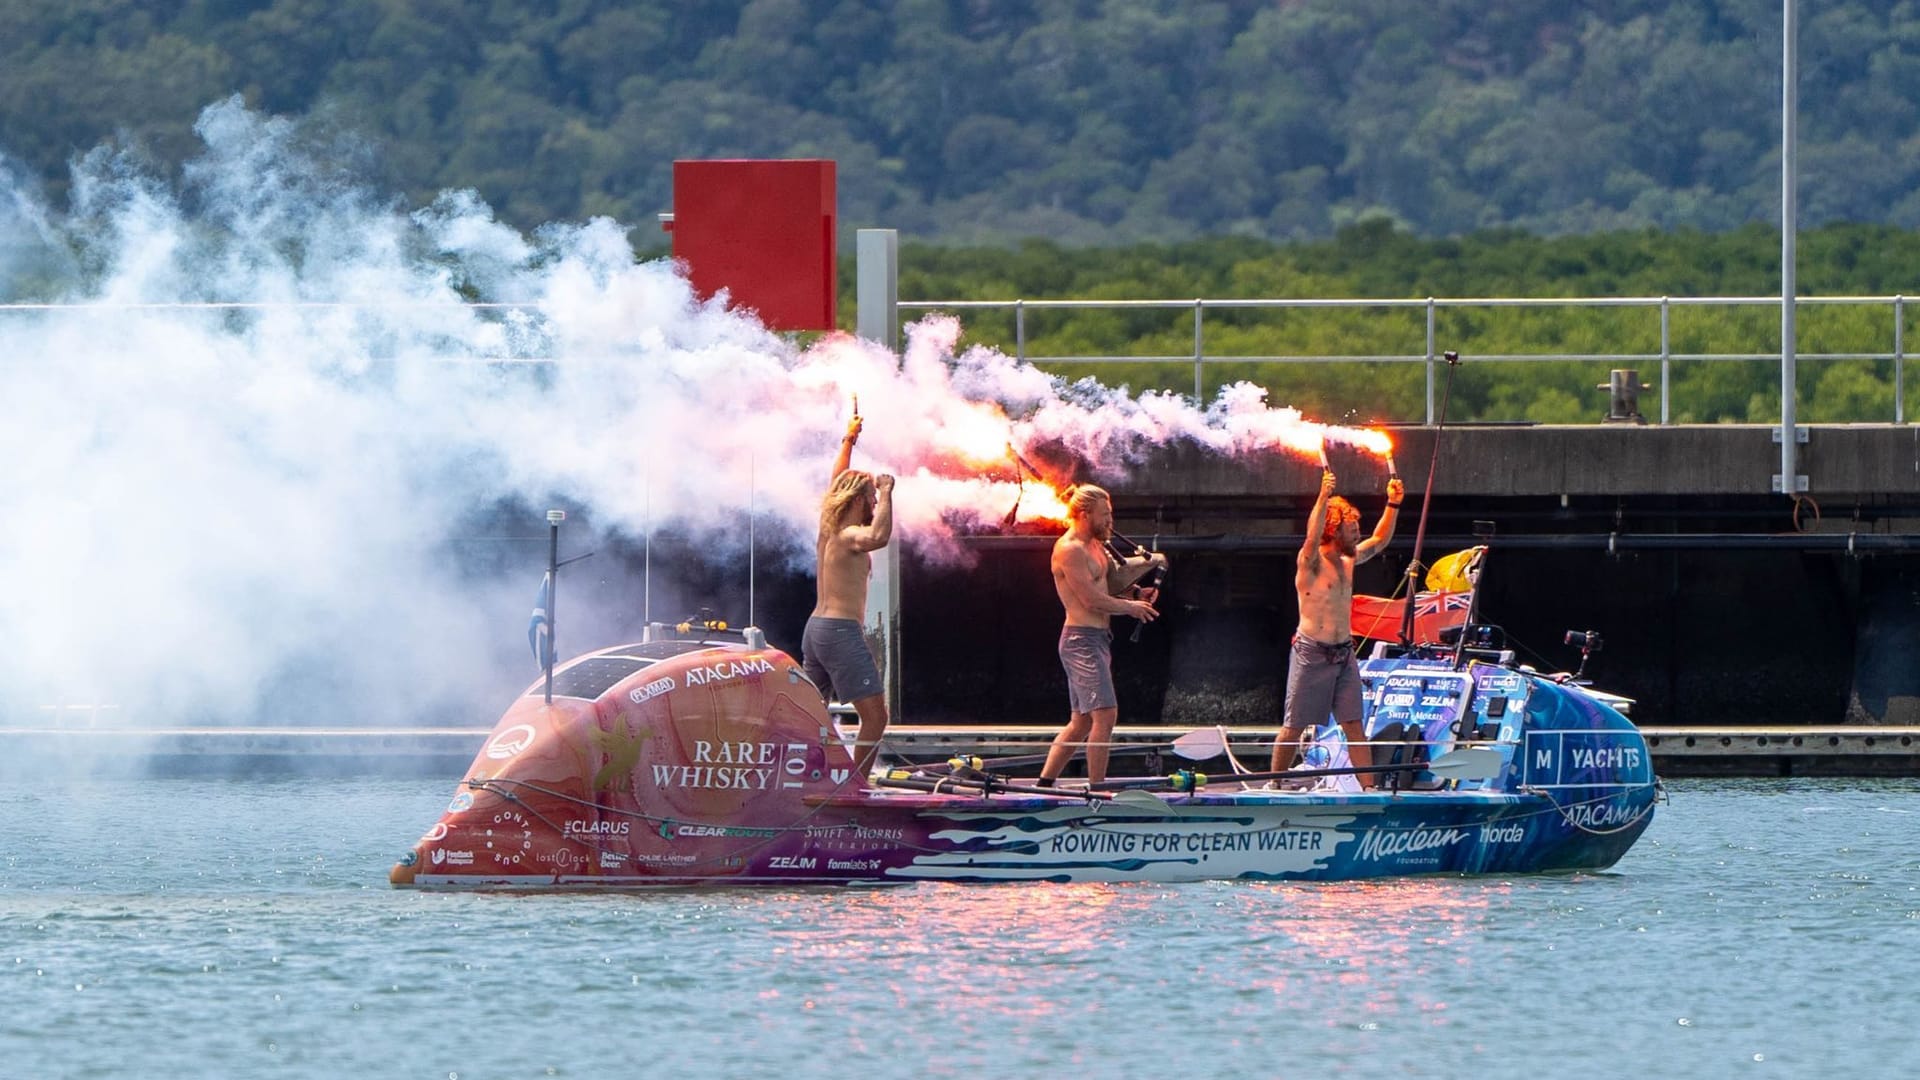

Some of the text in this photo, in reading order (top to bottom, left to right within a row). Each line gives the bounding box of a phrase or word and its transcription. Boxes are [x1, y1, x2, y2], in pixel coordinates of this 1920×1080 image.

[686, 659, 775, 687] ATACAMA
[1386, 679, 1421, 687] ATACAMA
[694, 740, 774, 764] RARE
[1536, 747, 1640, 769] M YACHTS
[783, 743, 808, 788] 101
[652, 764, 774, 790] WHISKY
[1561, 804, 1641, 827] ATACAMA
[571, 820, 630, 834] CLARUS
[804, 825, 903, 840] SWIFT MORRIS
[1479, 823, 1524, 843] norda
[1051, 830, 1323, 854] ROWING FOR CLEAN WATER
[1353, 822, 1471, 861] Maclean
[768, 855, 817, 869] ZELIM
[827, 858, 868, 870] formlabs
[1396, 857, 1439, 865] FOUNDATION
